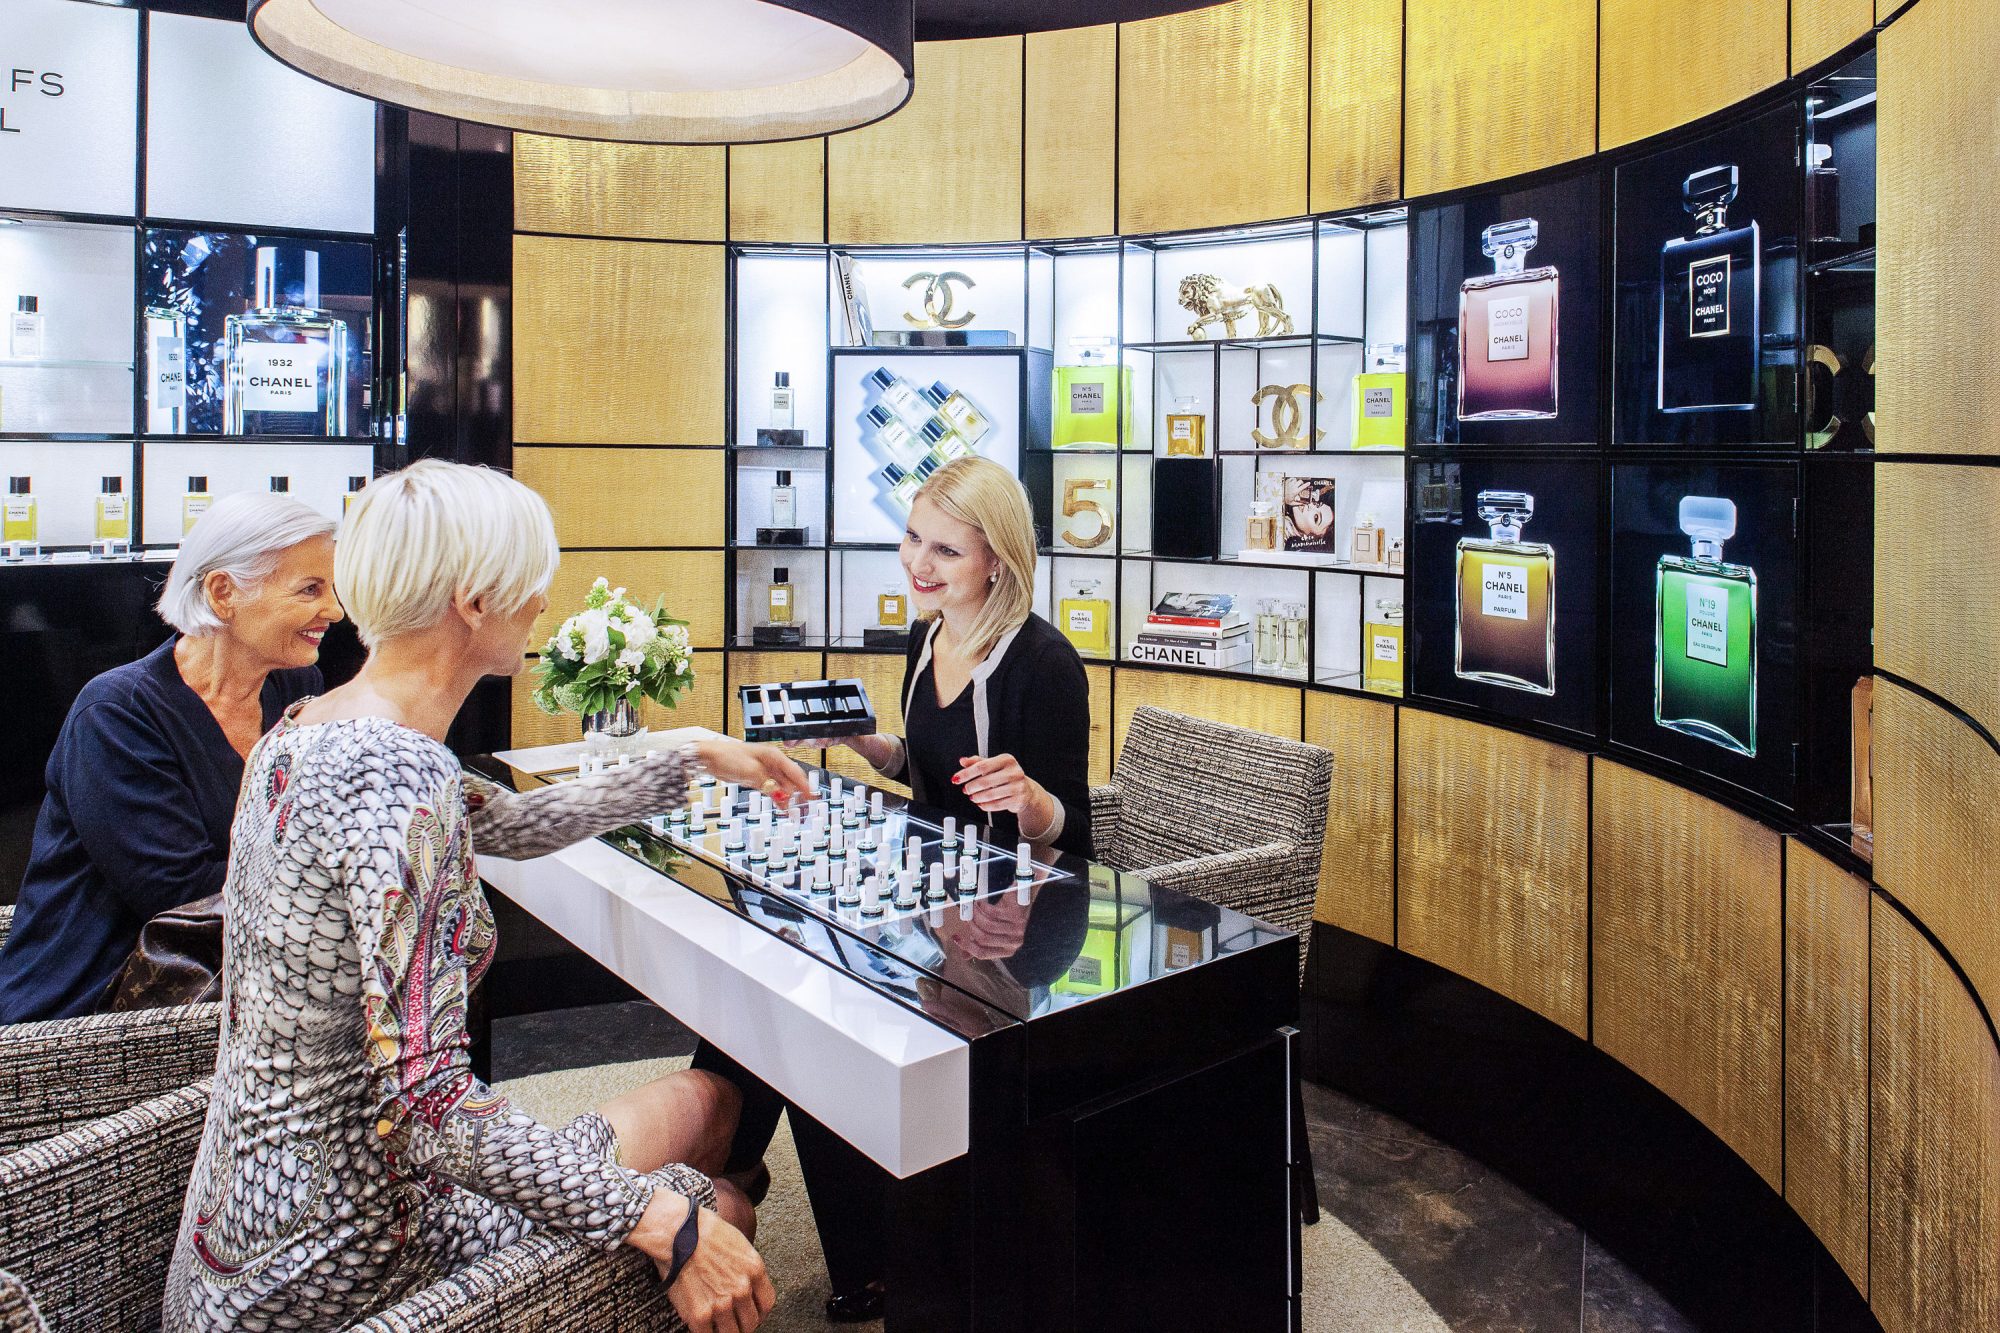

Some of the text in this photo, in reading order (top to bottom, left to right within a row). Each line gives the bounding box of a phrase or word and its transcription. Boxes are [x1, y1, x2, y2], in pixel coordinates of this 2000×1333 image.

[1696, 271, 1723, 286] COCO
[844, 272, 853, 300] CHANEL
[1703, 287, 1716, 295] NOIR
[1495, 307, 1523, 319] COCO
[1695, 304, 1724, 317] CHANEL
[1493, 334, 1524, 344] CHANEL
[268, 359, 293, 367] 1932
[249, 376, 313, 388] CHANEL
[1062, 479, 1114, 549] 5
[1485, 580, 1525, 594] CHANEL
[1493, 606, 1517, 614] PARFUM
[1691, 617, 1723, 633] CHANEL
[1375, 643, 1397, 651] CHANEL
[1131, 645, 1206, 666] CHANEL
